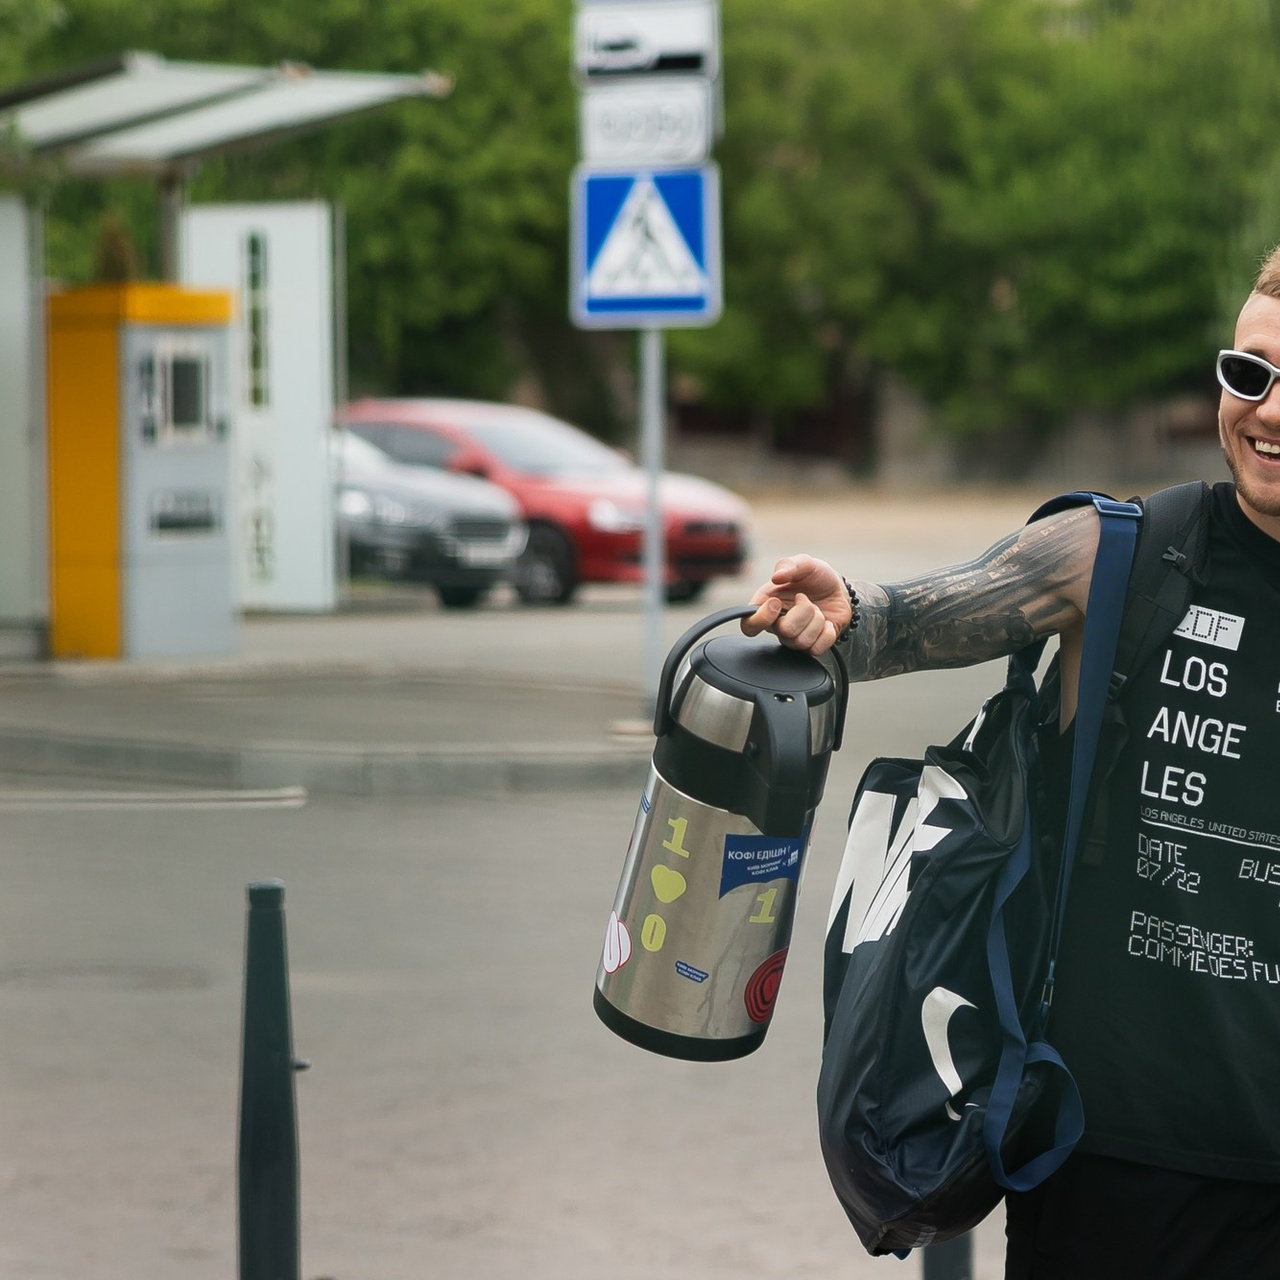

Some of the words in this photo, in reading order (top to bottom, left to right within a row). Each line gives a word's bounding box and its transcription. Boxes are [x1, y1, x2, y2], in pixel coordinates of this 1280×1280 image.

[1160, 649, 1228, 697] LOS
[1147, 706, 1247, 759] ANGE
[1140, 761, 1207, 806] LES
[1140, 805, 1159, 819] LOS
[1160, 811, 1204, 829] ANGELES
[1208, 821, 1246, 839] UNITED
[728, 851, 755, 860] КОФІ
[757, 847, 786, 860] ЕДІШН
[1138, 833, 1187, 867] DATE
[1130, 911, 1253, 958] PASSENGER:
